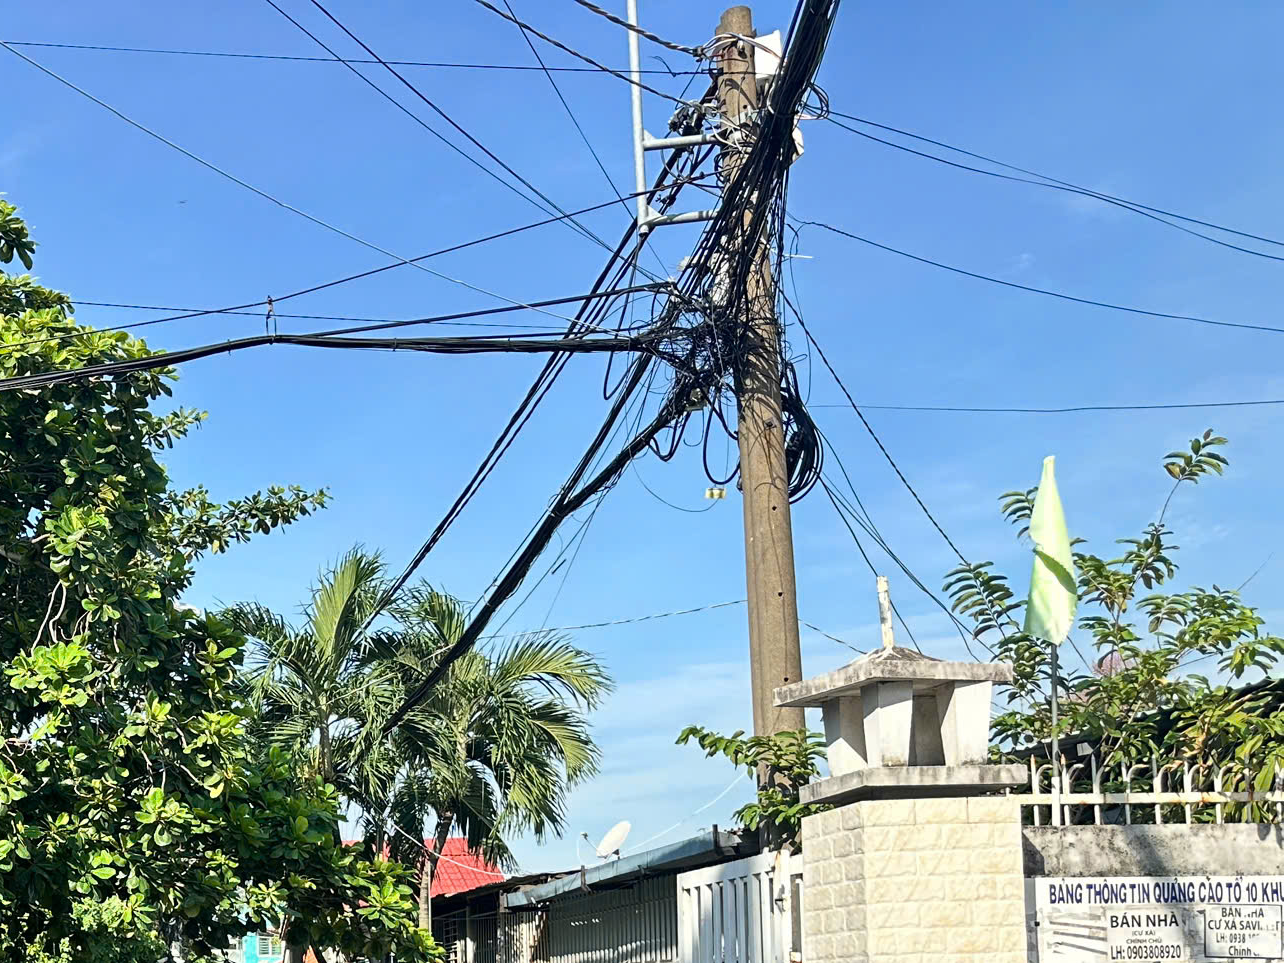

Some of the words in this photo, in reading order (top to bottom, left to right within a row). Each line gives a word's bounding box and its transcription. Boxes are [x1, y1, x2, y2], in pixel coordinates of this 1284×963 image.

[1049, 878, 1083, 904] BẢNG
[1086, 879, 1127, 904] THÔNG
[1129, 882, 1150, 904] TIN
[1153, 877, 1195, 904] QUẢNG
[1226, 876, 1242, 903] TỔ
[1246, 882, 1258, 903] 10
[1110, 912, 1141, 928] BÁN
[1146, 911, 1179, 927] NHÀ
[1207, 919, 1222, 930] CƯ
[1224, 918, 1237, 930] XÁ
[1110, 945, 1125, 960] LH:
[1127, 944, 1181, 959] 0903808920
